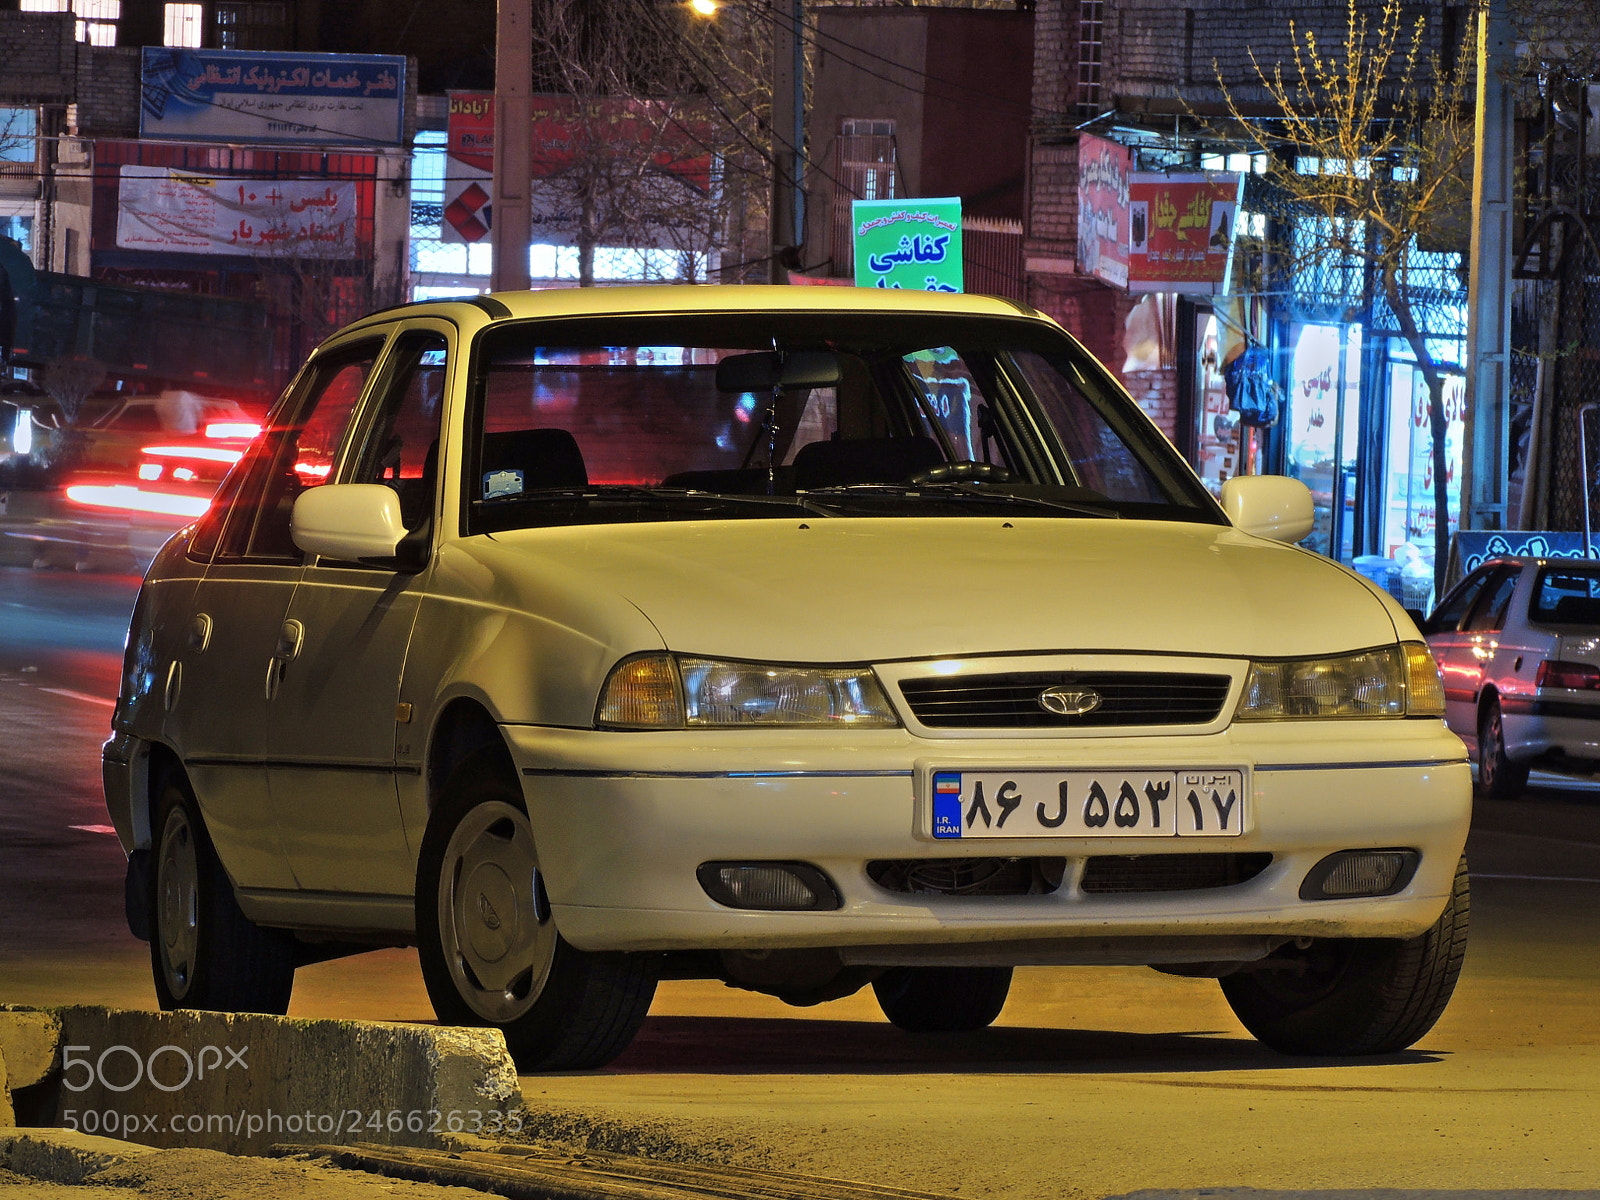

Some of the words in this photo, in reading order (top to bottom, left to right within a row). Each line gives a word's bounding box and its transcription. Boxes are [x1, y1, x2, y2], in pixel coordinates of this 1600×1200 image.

[187, 64, 241, 91] انتظامی
[243, 66, 310, 93] الکترونیک
[312, 68, 361, 89] خدمات
[366, 70, 396, 96] دفتر
[235, 98, 257, 110] اسلامی
[258, 101, 283, 111] جمهوری
[285, 100, 306, 112] انتظامی
[450, 98, 491, 120] آپادانا
[290, 187, 338, 214] پلیس
[887, 210, 906, 224] کفش
[909, 211, 928, 223] کیف
[926, 213, 958, 231] تعمیرات
[1178, 191, 1212, 242] کفاشی
[226, 219, 291, 246] شهریار
[297, 221, 345, 241] استاد
[868, 234, 951, 274] کفاشی
[1185, 774, 1232, 786] ایران
[966, 780, 1022, 828] ۸۶
[1036, 780, 1068, 828] ل
[1082, 779, 1171, 828] ۵۵۳
[1186, 788, 1236, 831] ۱۷
[936, 817, 951, 825] I.R.
[936, 826, 960, 834] IRAN
